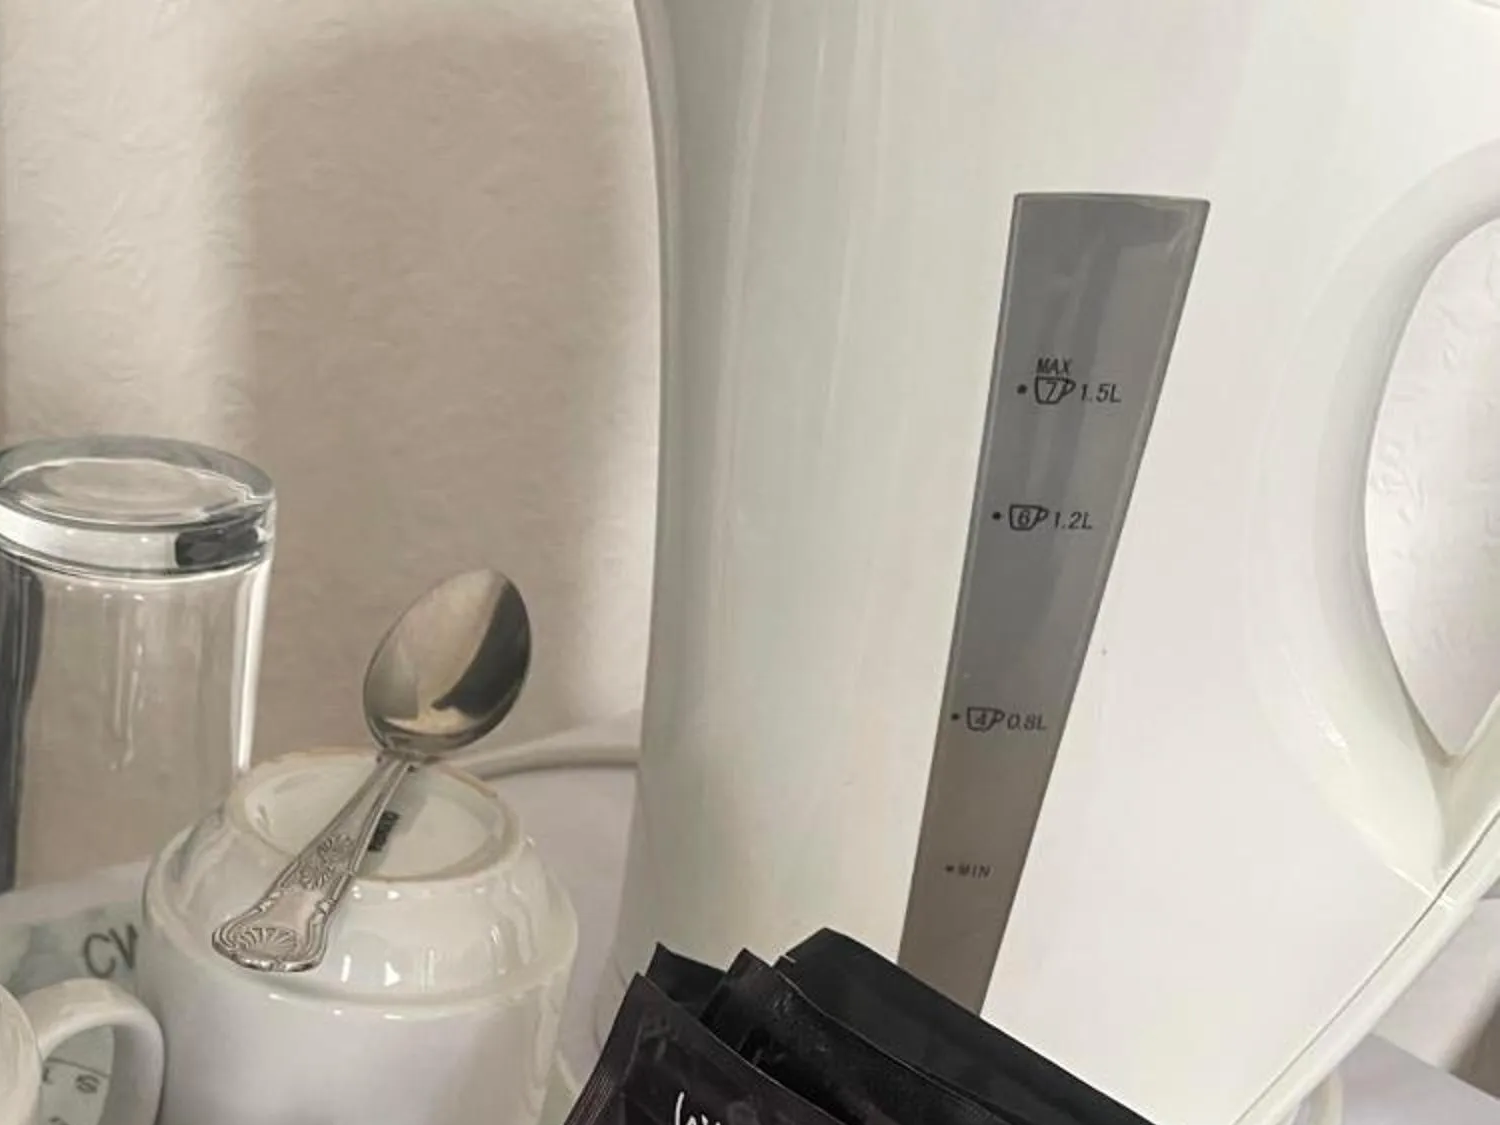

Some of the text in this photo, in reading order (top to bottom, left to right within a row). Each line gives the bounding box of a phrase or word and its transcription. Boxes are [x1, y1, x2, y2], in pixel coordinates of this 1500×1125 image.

[1036, 358, 1072, 374] MAX
[1081, 383, 1122, 403] 1.5L
[1055, 511, 1092, 530] 1.2L
[1007, 712, 1047, 731] 0.8L
[958, 863, 991, 879] MIN
